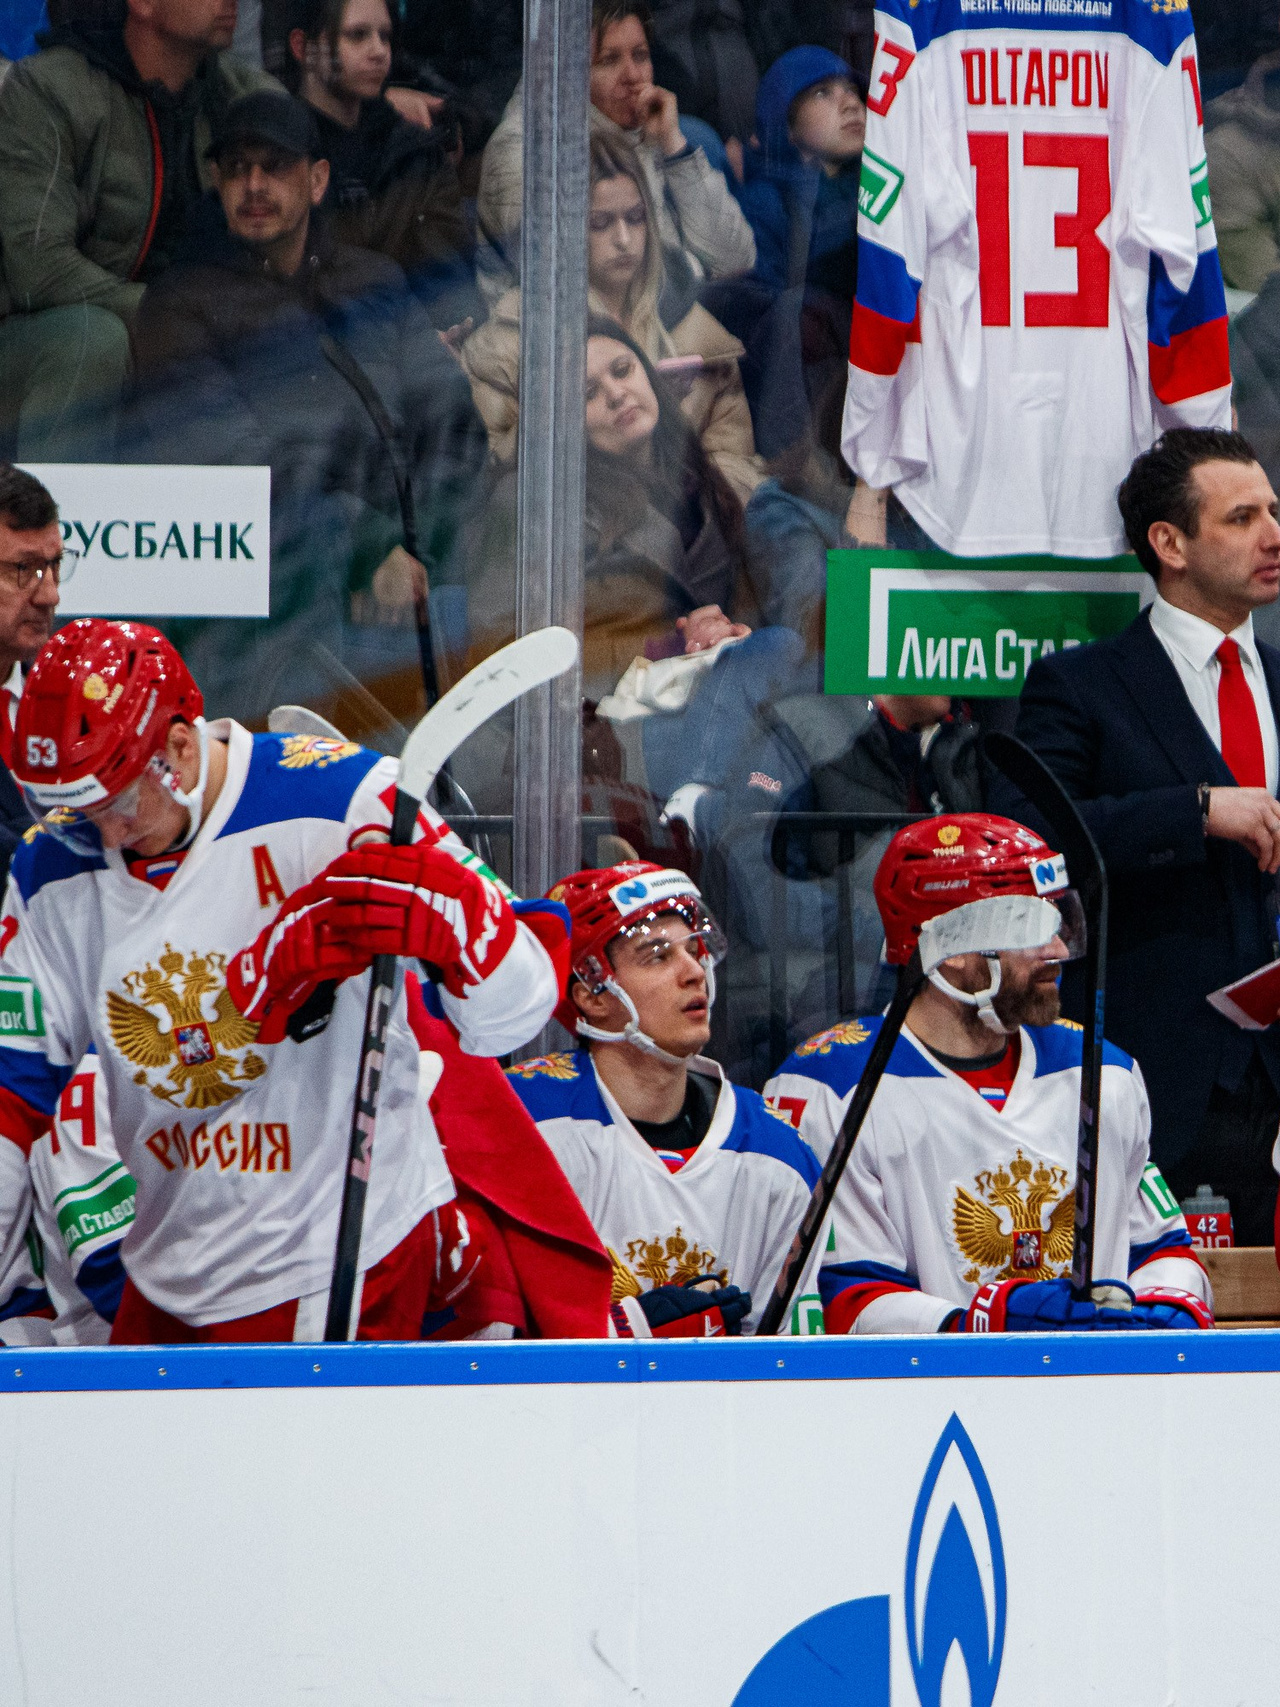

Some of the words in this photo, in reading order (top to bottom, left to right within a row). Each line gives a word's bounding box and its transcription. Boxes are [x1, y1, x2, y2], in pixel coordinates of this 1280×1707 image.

[867, 31, 916, 117] 3
[960, 48, 1109, 109] OLTAPOV
[967, 131, 1111, 327] 13
[26, 734, 58, 768] 53
[145, 1120, 292, 1173] РОССИЯ
[1197, 1216, 1218, 1234] 42
